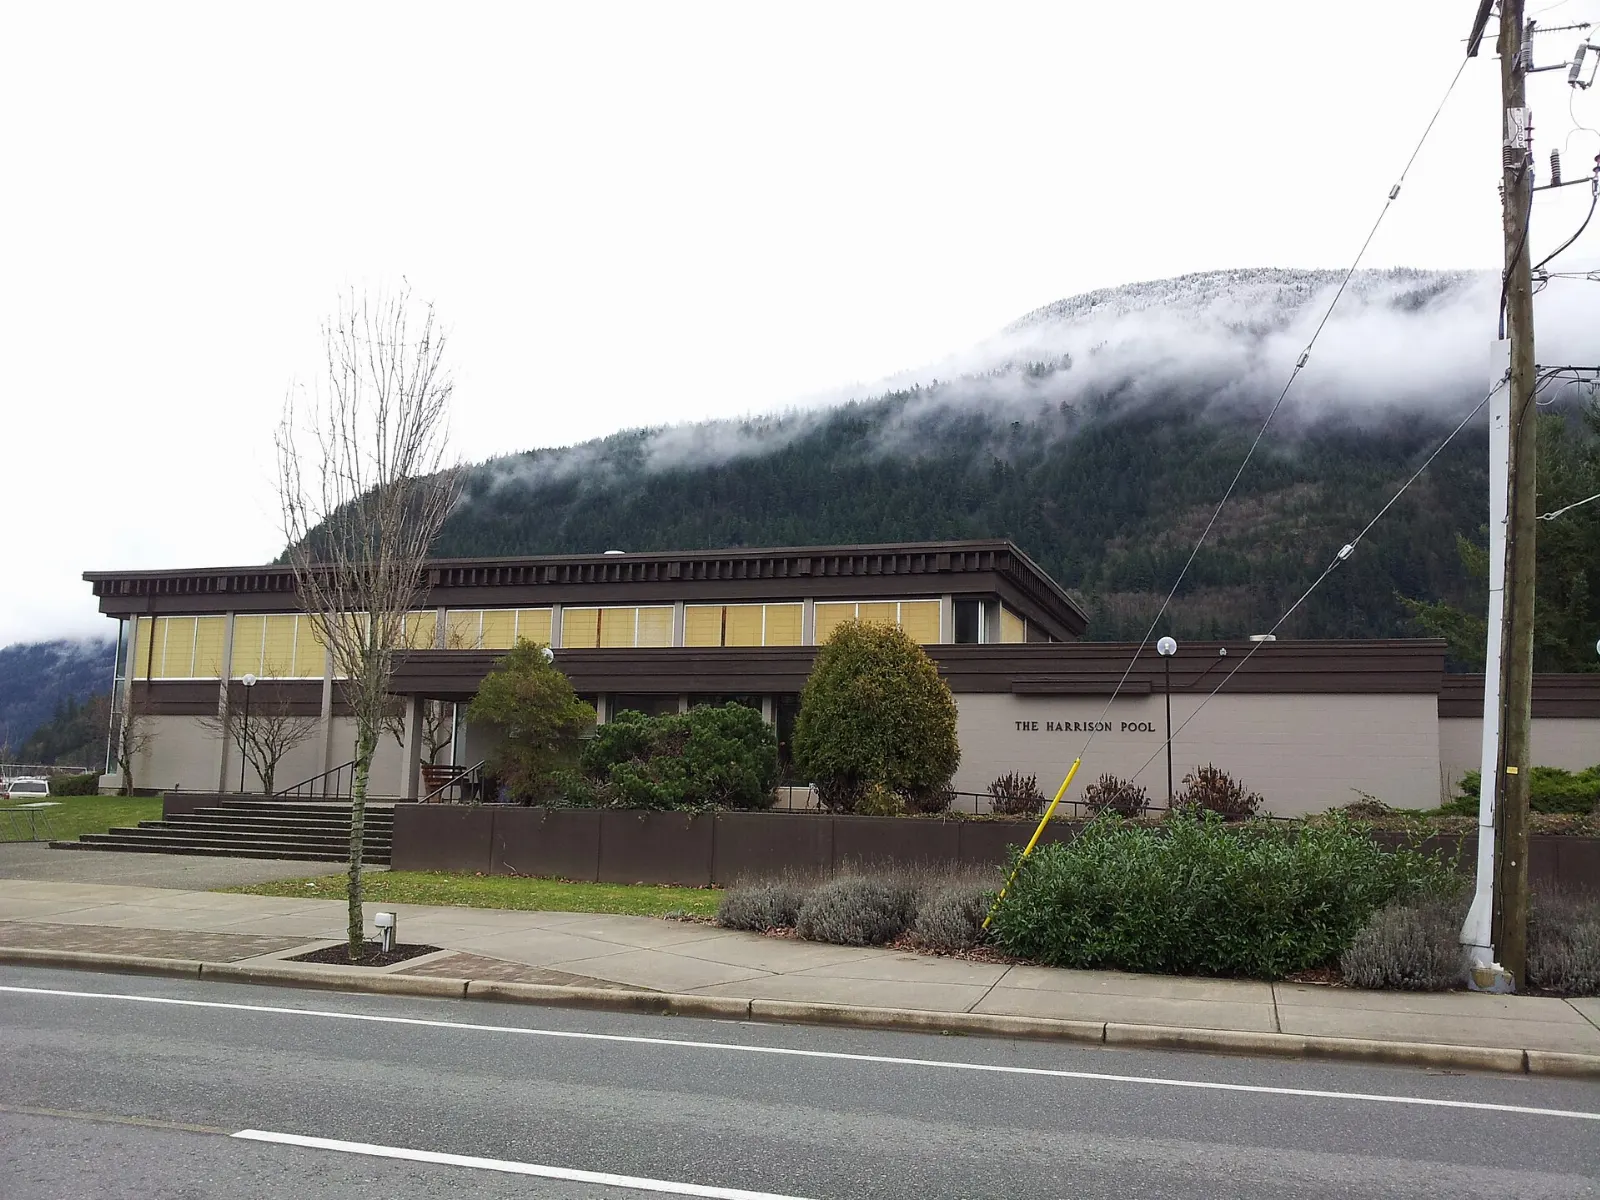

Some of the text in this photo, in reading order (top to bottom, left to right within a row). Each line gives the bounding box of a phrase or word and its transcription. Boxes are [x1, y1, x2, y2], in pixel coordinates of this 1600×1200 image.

[1015, 721, 1156, 733] THE HARRISON POOL
